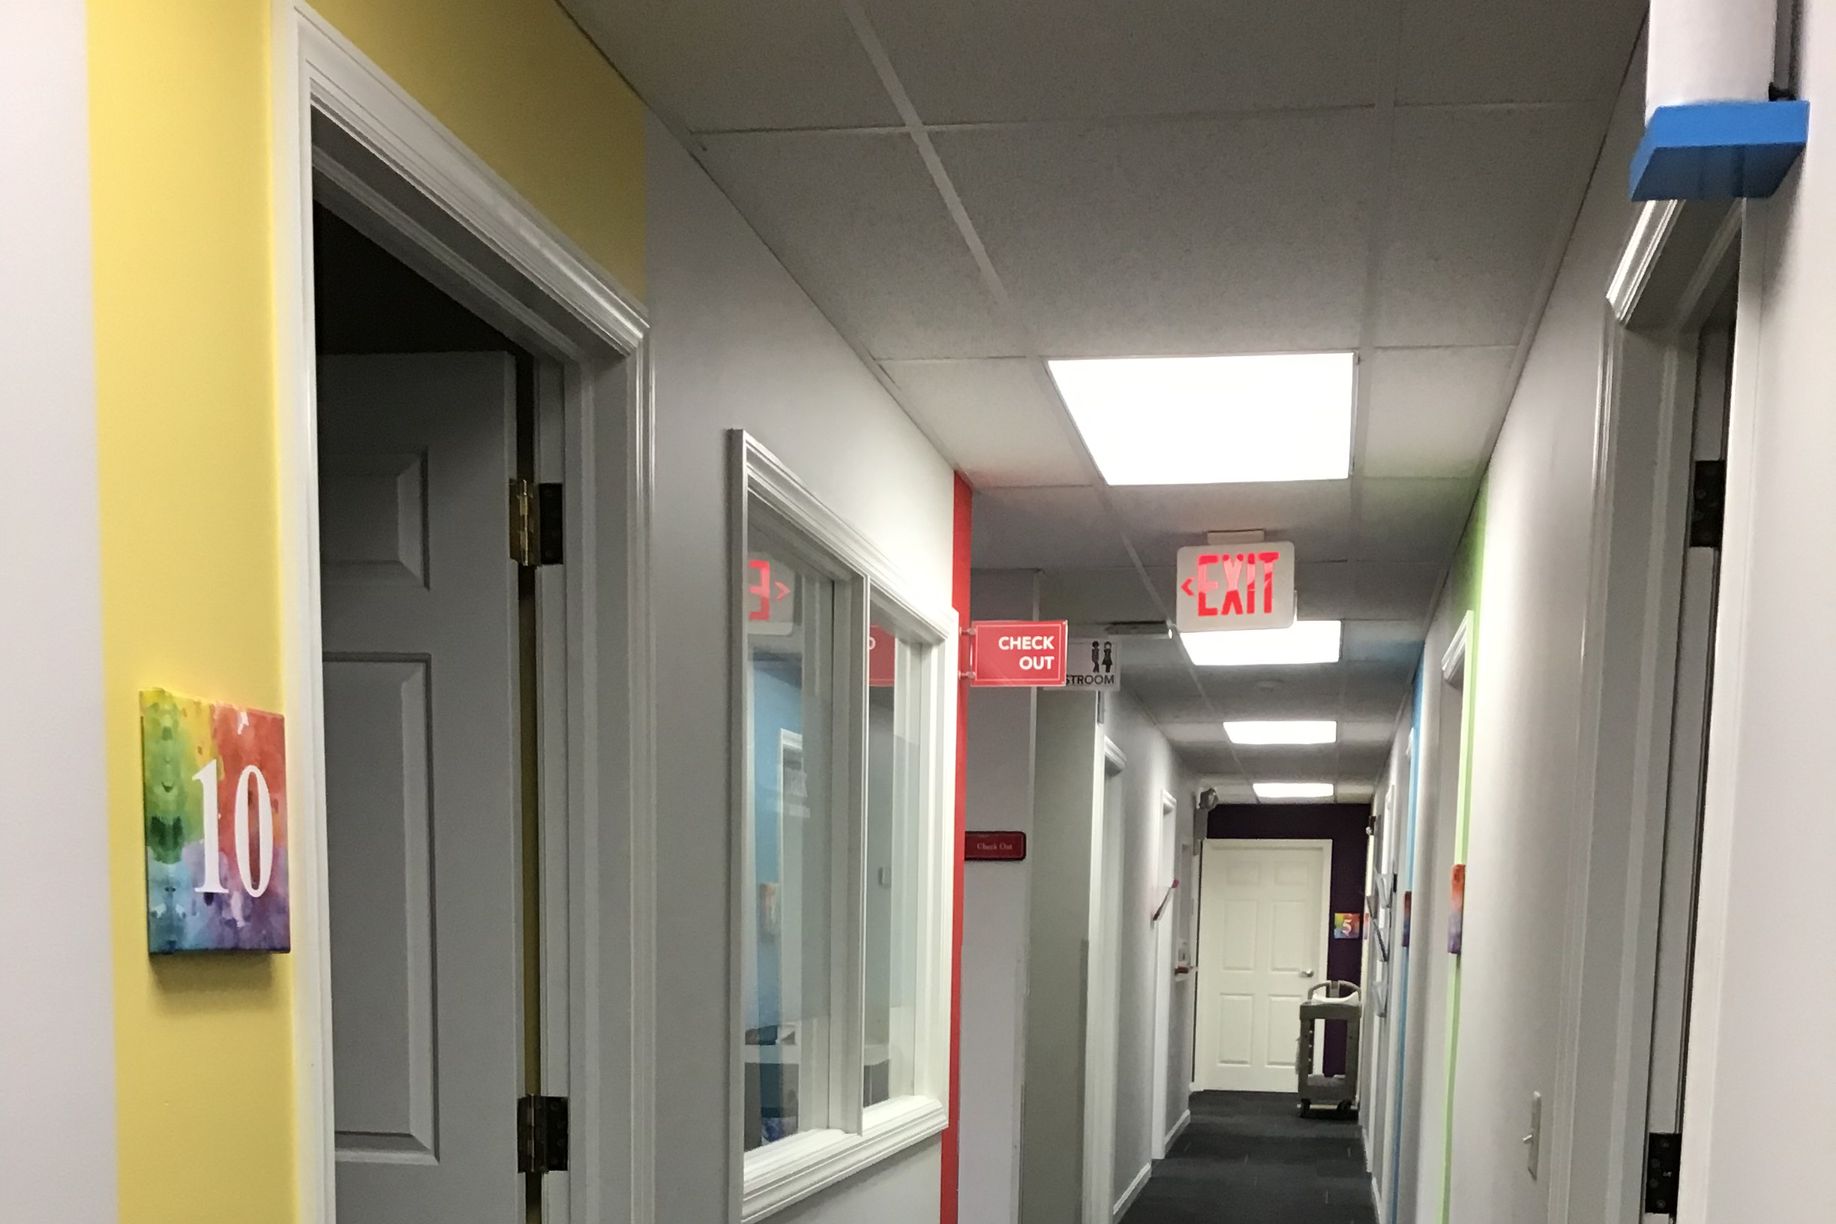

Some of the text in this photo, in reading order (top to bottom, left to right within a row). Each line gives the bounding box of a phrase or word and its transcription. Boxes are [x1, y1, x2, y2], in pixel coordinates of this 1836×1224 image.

[1197, 552, 1280, 616] EXIT
[998, 636, 1054, 650] CHECK
[1019, 656, 1054, 670] OUT
[192, 759, 273, 898] 10
[1342, 919, 1352, 936] 5
